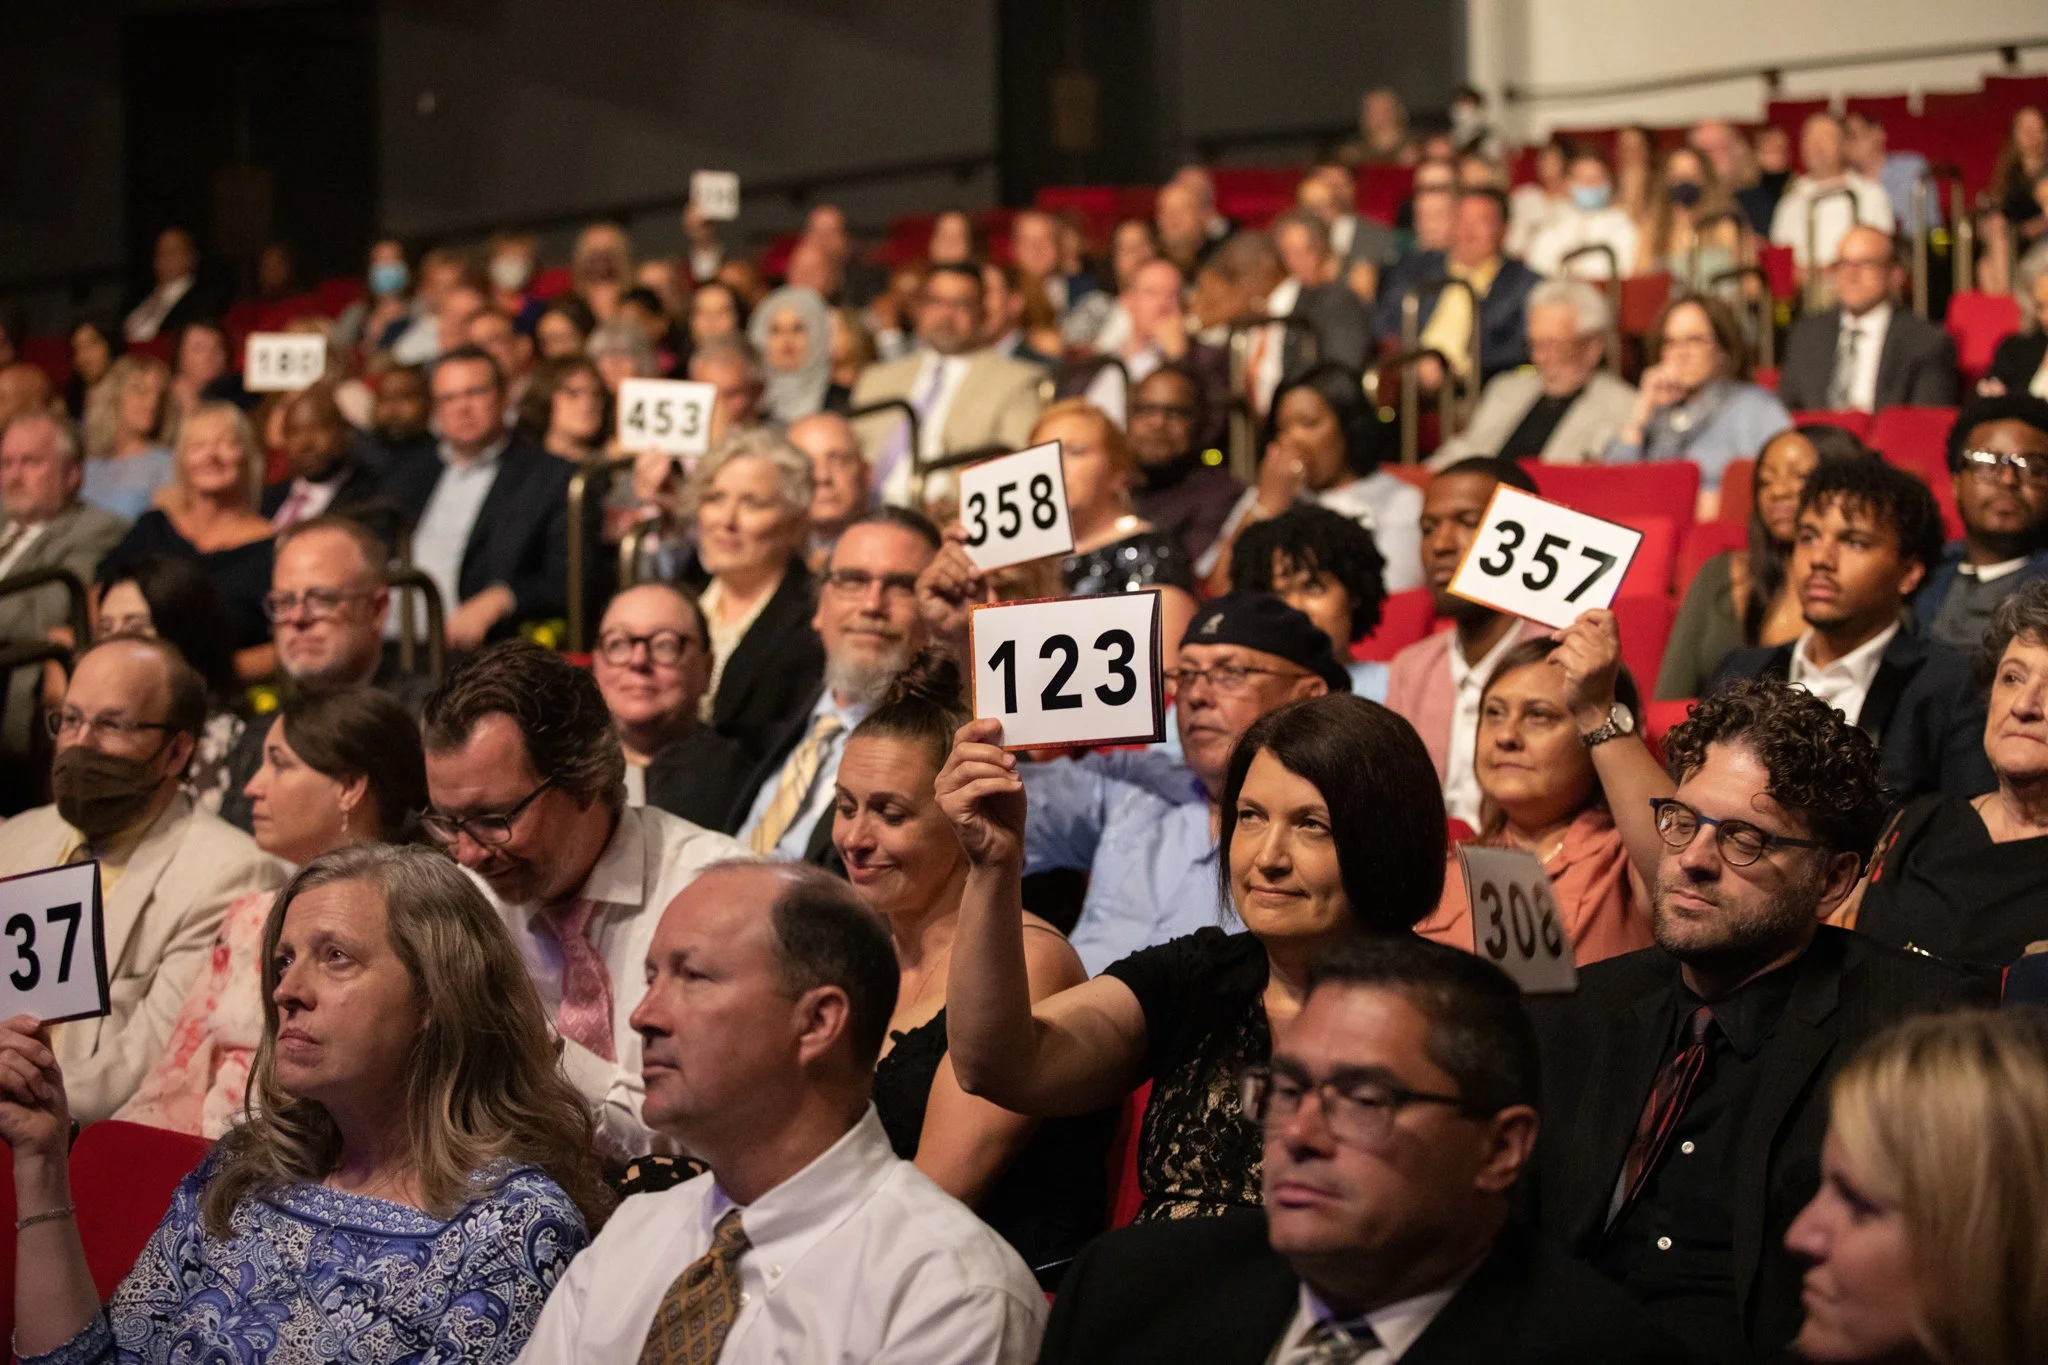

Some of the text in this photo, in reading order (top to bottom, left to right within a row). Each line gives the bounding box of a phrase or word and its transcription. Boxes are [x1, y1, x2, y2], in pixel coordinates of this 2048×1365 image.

[627, 400, 701, 437] 453
[966, 473, 1057, 547] 358
[1479, 520, 1618, 603] 357
[988, 629, 1137, 714] 123
[5, 902, 82, 991] 37
